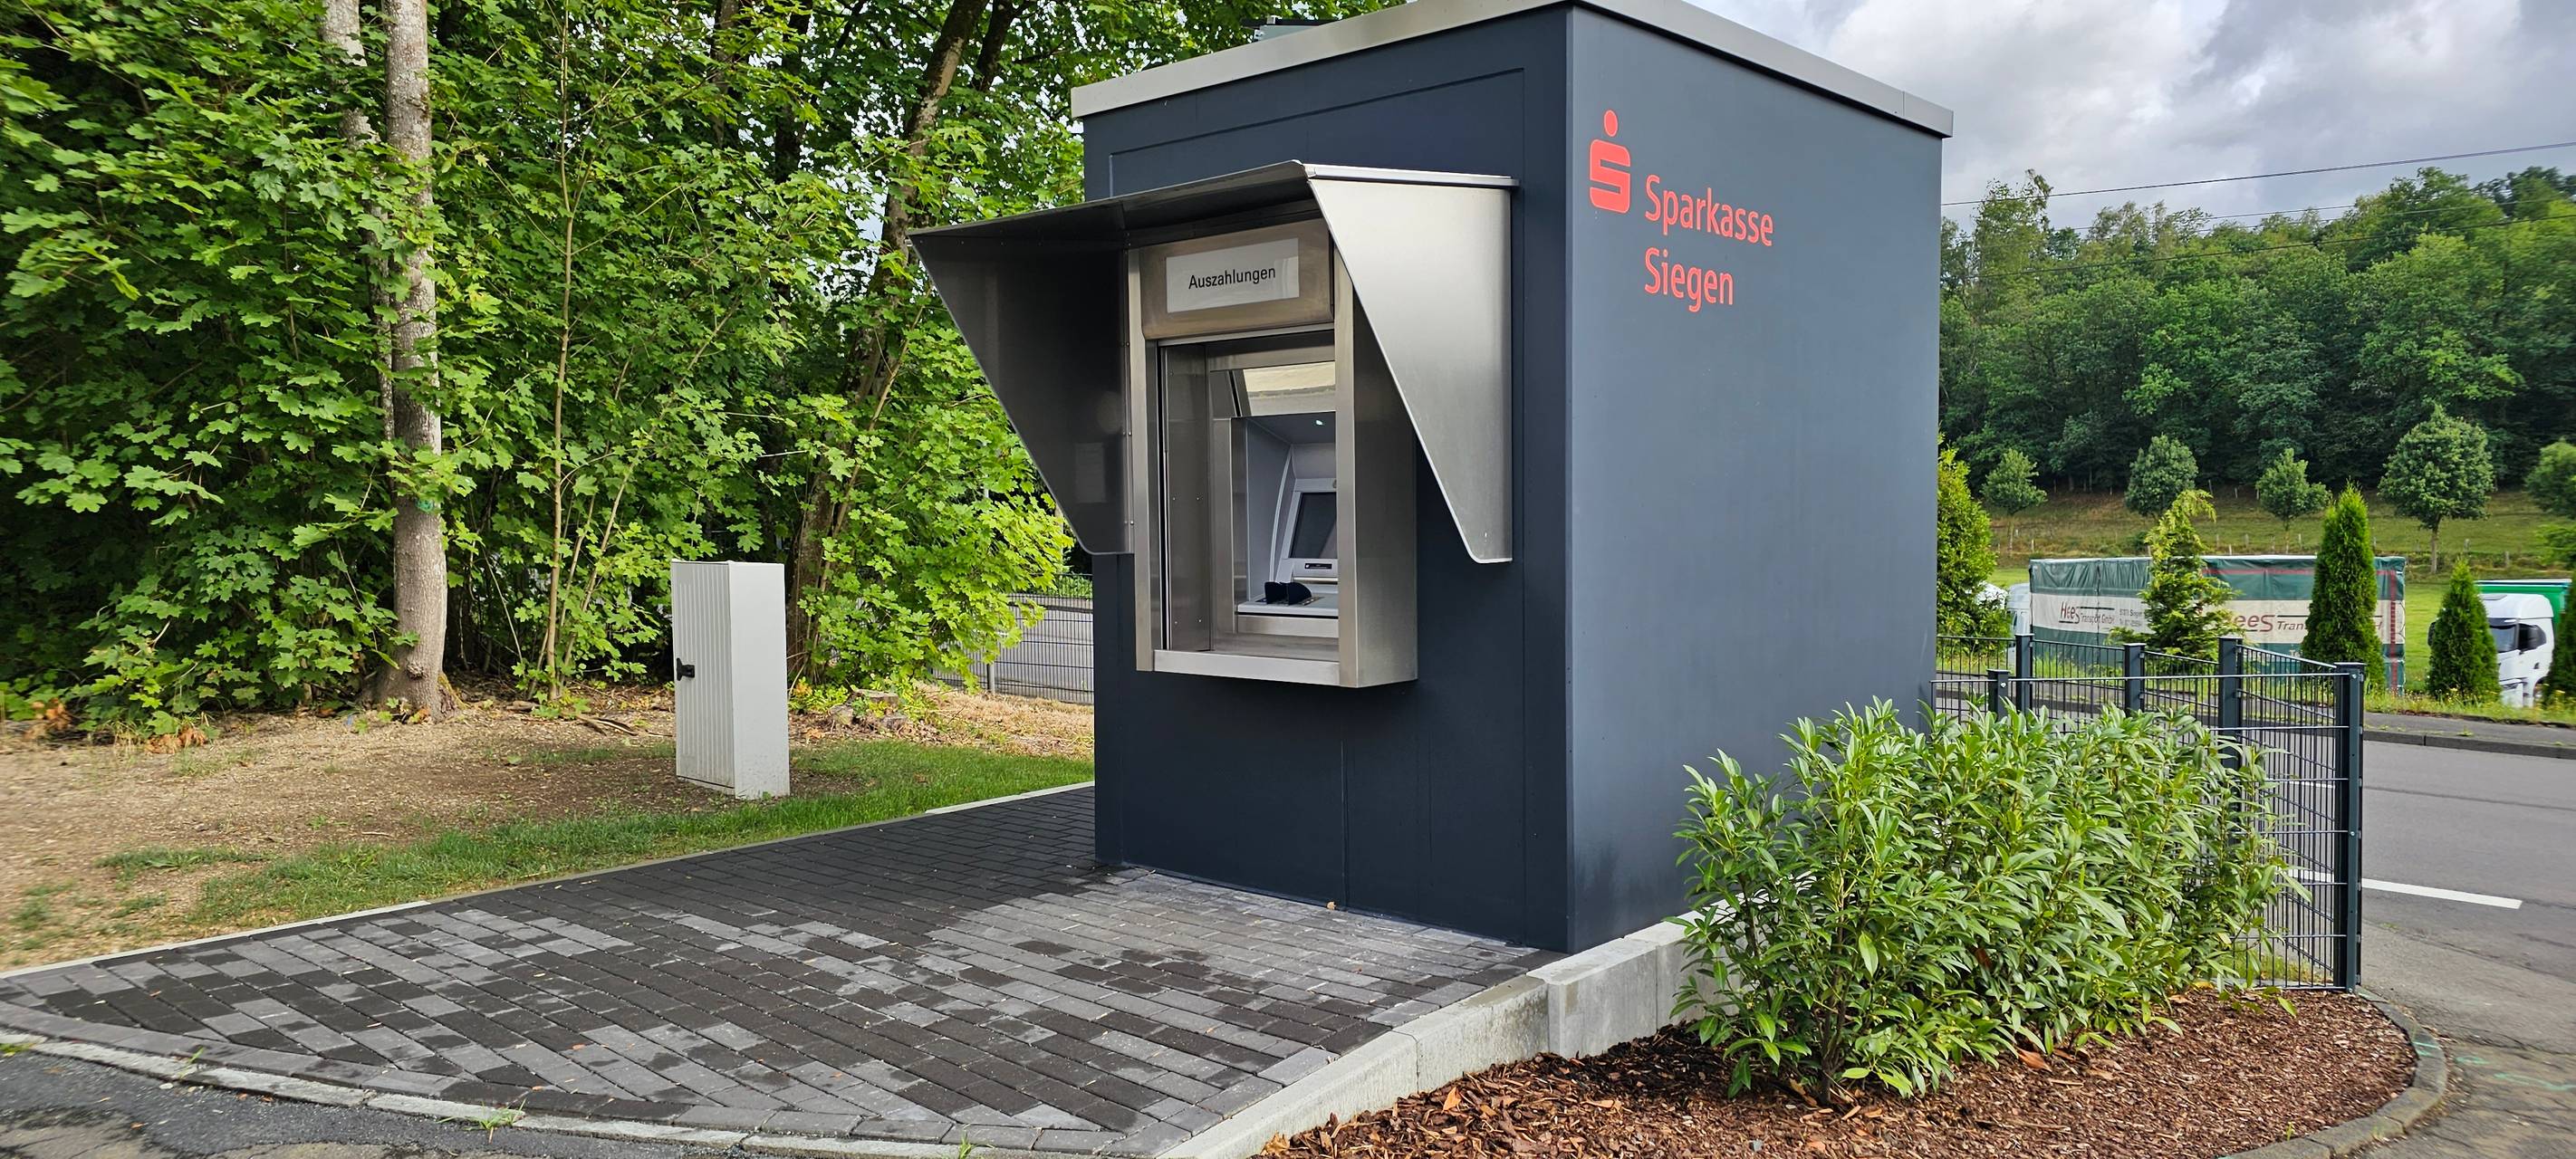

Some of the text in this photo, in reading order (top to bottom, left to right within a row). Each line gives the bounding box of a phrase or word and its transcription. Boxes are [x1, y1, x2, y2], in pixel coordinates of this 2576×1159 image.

[1644, 174, 1774, 247] Sparkasse
[1188, 267, 1276, 290] Auszahlungen
[1644, 246, 1735, 312] Siegen
[2060, 601, 2080, 624] Hees
[2234, 615, 2275, 632] ees
